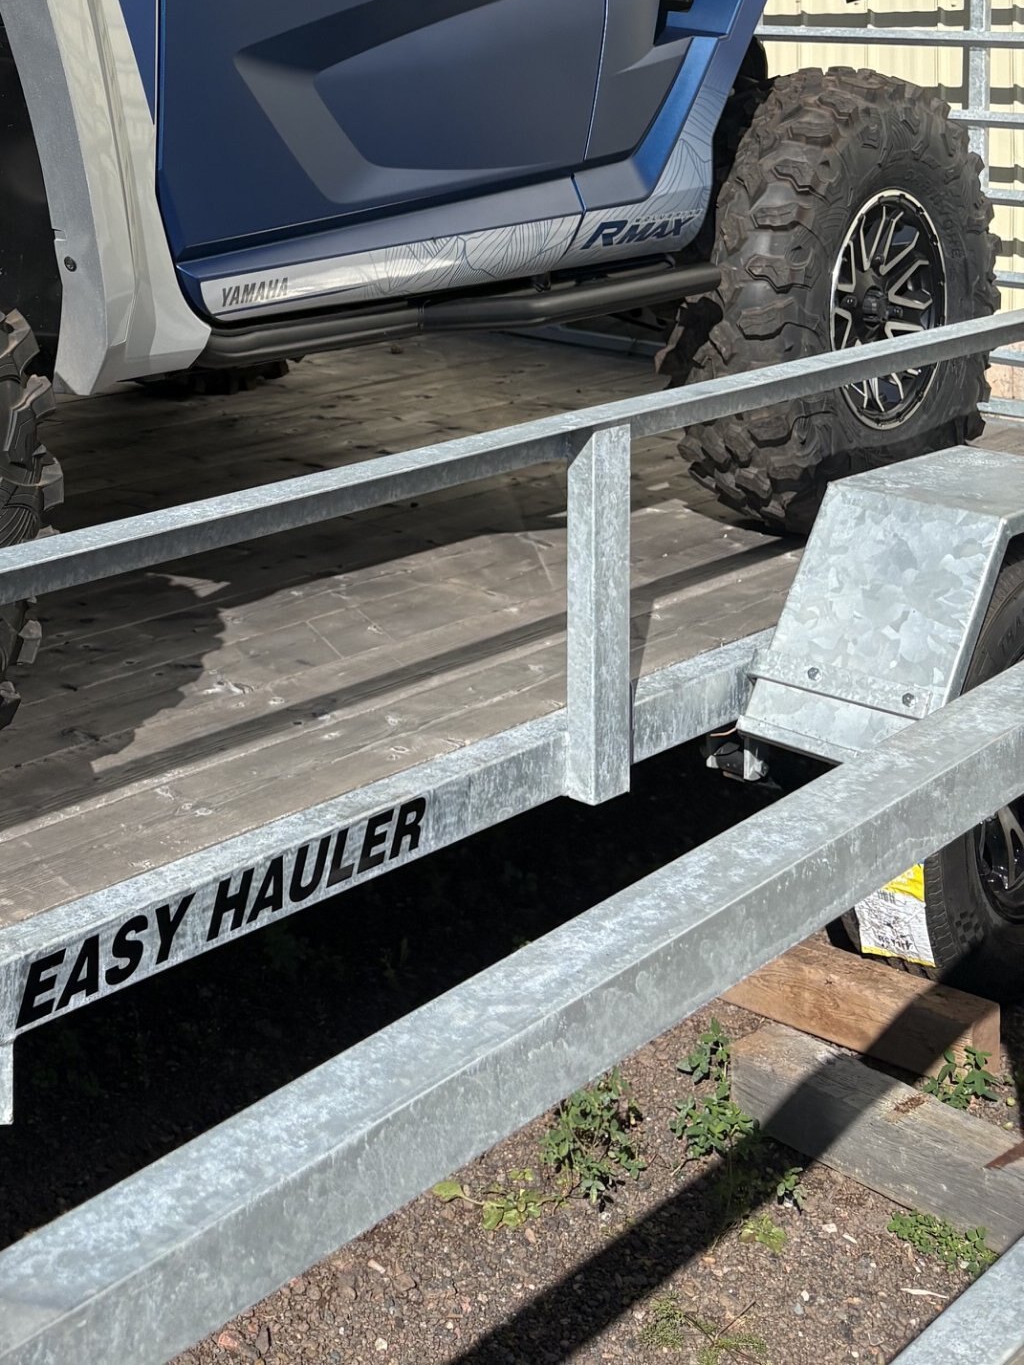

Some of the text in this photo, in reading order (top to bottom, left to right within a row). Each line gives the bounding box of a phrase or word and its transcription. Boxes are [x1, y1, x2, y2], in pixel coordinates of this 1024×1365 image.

[580, 220, 695, 250] RMAX
[222, 277, 288, 307] YAMAHA
[16, 796, 426, 1030] EASY HAULER
